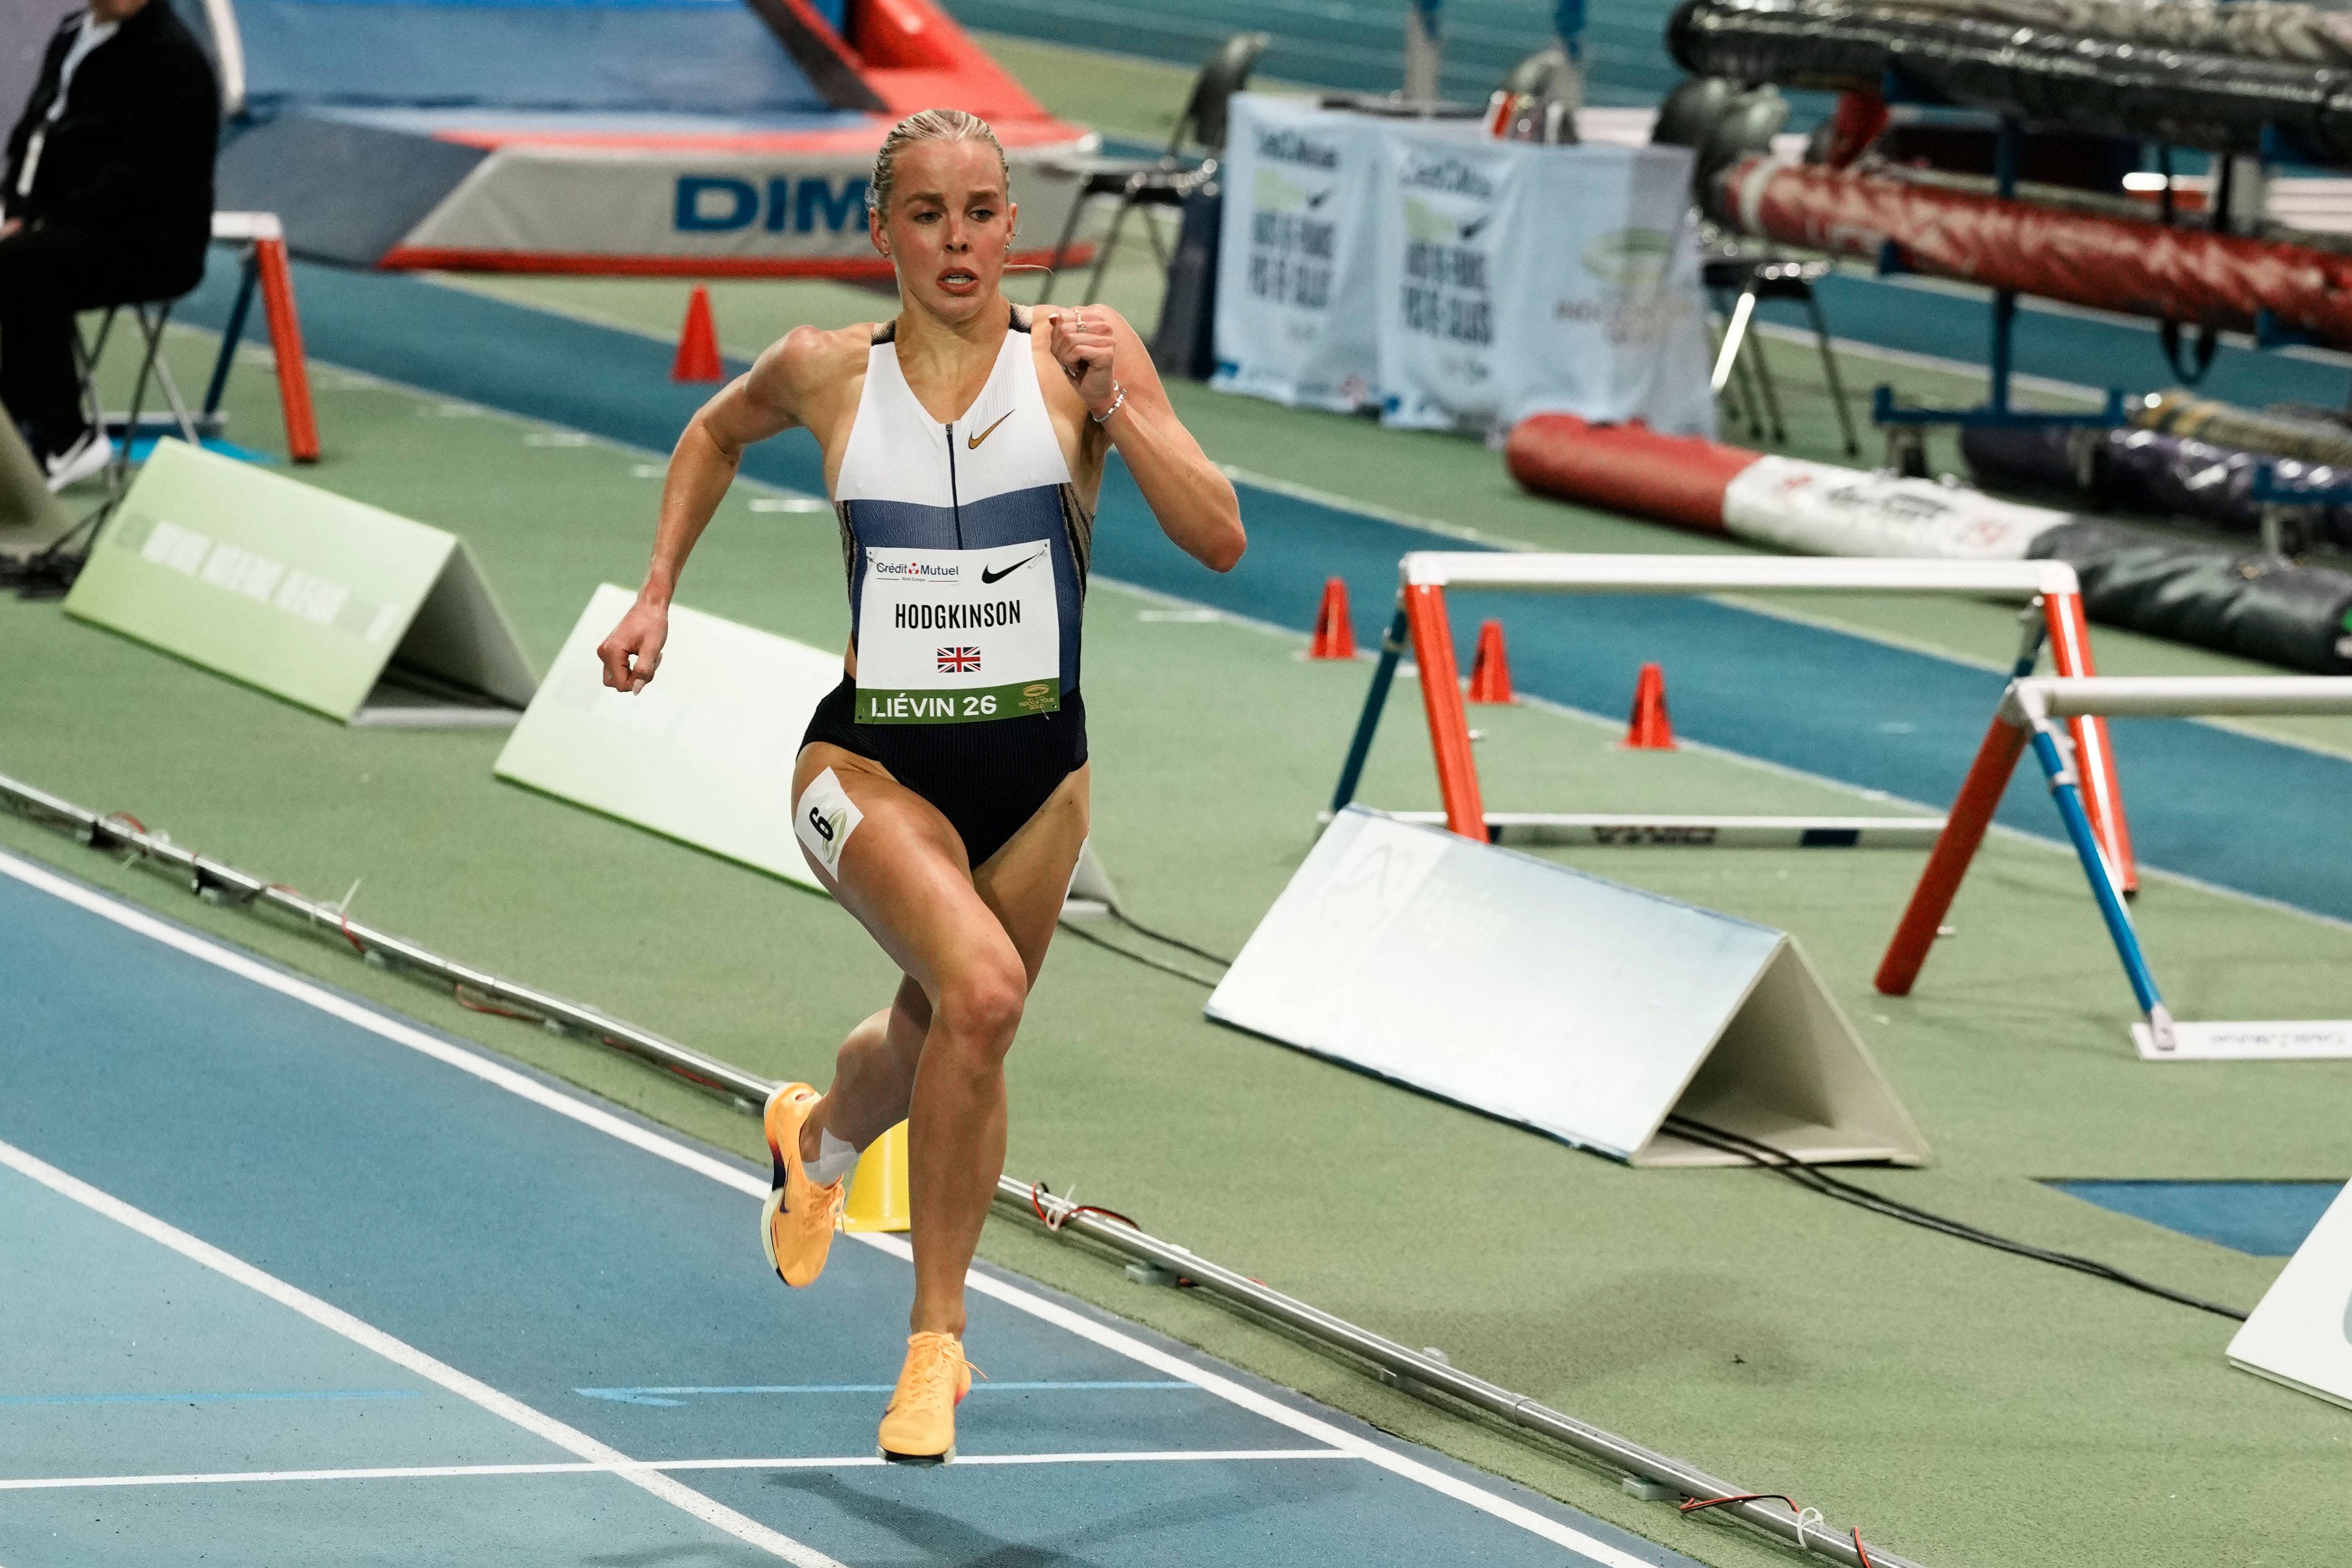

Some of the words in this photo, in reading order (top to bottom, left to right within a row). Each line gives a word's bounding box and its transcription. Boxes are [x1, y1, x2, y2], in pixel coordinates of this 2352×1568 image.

[876, 562, 908, 573] Crédit
[921, 564, 959, 575] Mutuel
[895, 600, 1021, 629] HODGKINSON
[871, 693, 954, 717] LIÉVIN
[963, 695, 997, 716] 26
[809, 806, 834, 841] 6
